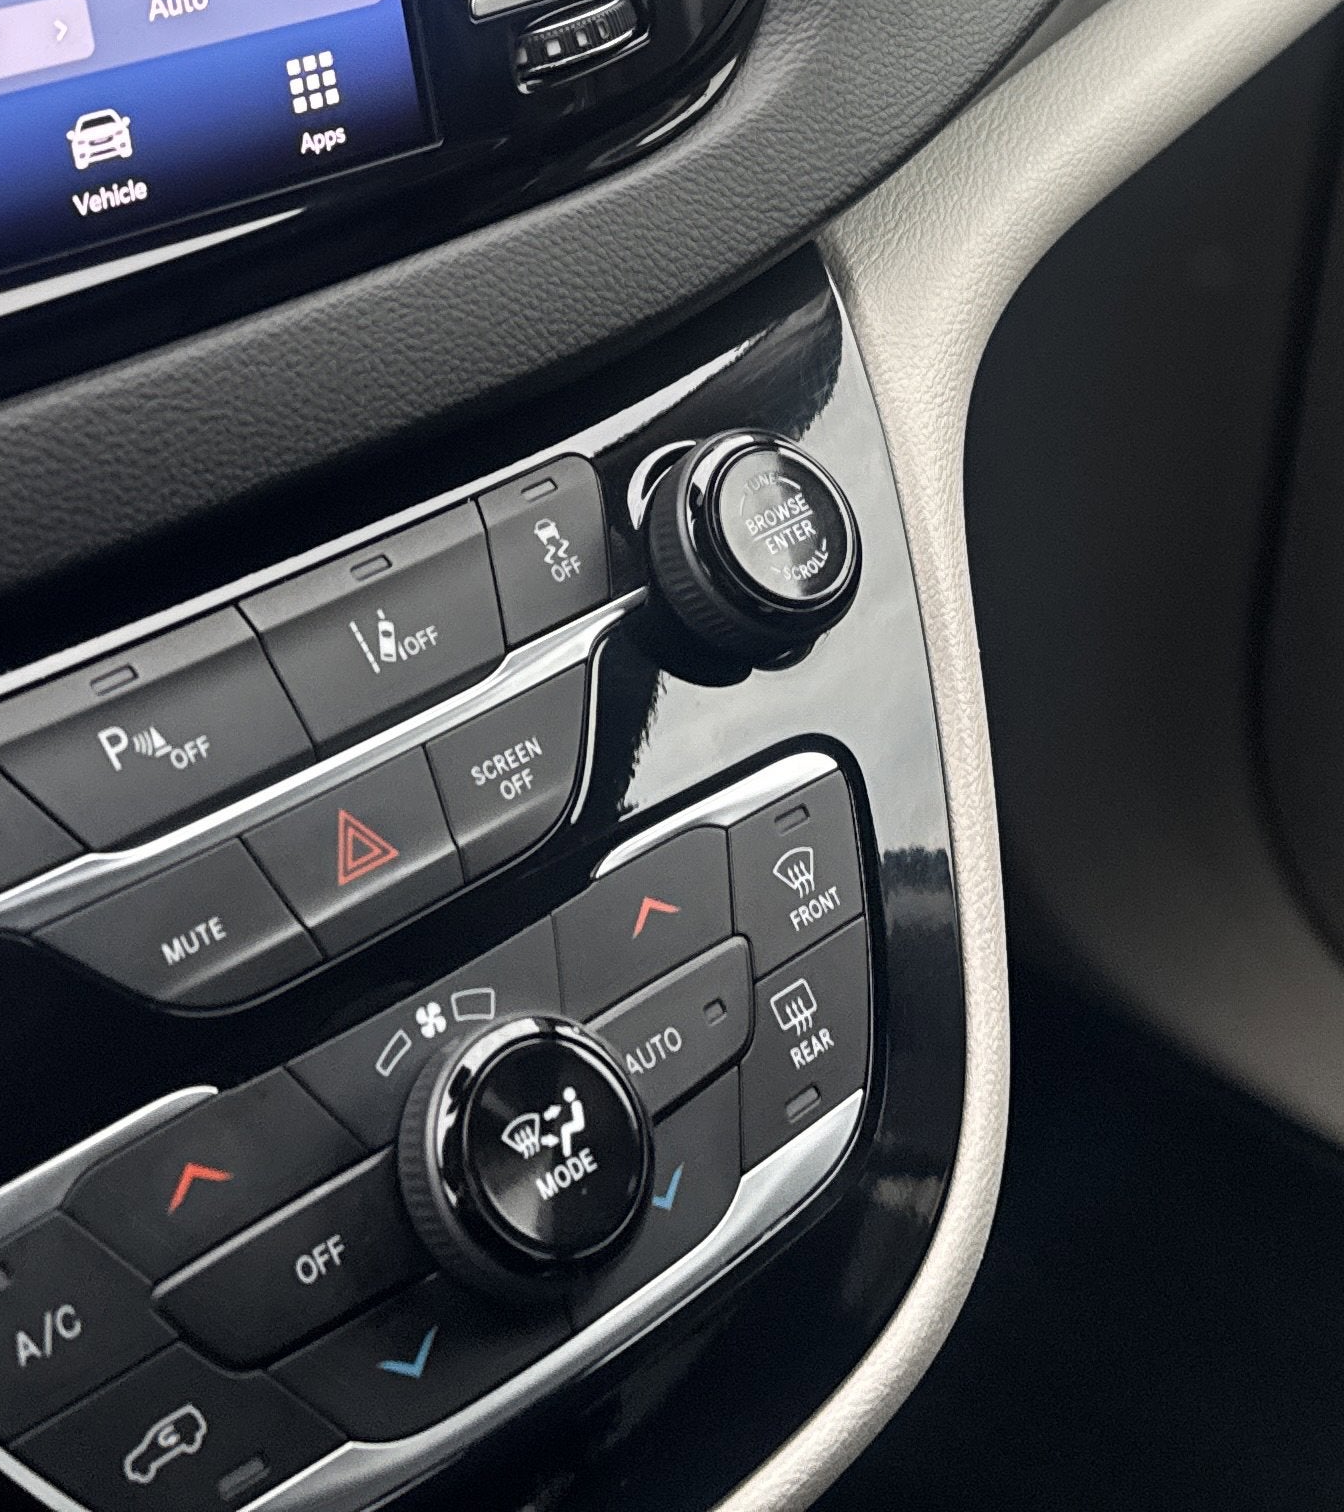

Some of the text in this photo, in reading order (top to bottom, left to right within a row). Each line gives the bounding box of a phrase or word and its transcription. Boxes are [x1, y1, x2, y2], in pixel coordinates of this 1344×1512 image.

[299, 123, 348, 156] Apps
[72, 178, 149, 216] Vehicle
[745, 472, 778, 494] TUNE
[745, 492, 810, 537] BROWSE
[764, 519, 817, 556] ENTER
[552, 557, 582, 583] OFF
[782, 549, 829, 581] SCROLL
[405, 625, 439, 658] OFF
[97, 726, 211, 771] P OFF
[470, 738, 544, 788] SCREEN
[499, 768, 536, 801] OFF
[789, 885, 842, 932] FRONT
[161, 915, 227, 966] MUTE
[624, 1026, 683, 1078] AUTO
[789, 1027, 835, 1070] REAR
[534, 1146, 599, 1201] MODE
[294, 1233, 347, 1285] OFF
[14, 1303, 83, 1368] A/C
